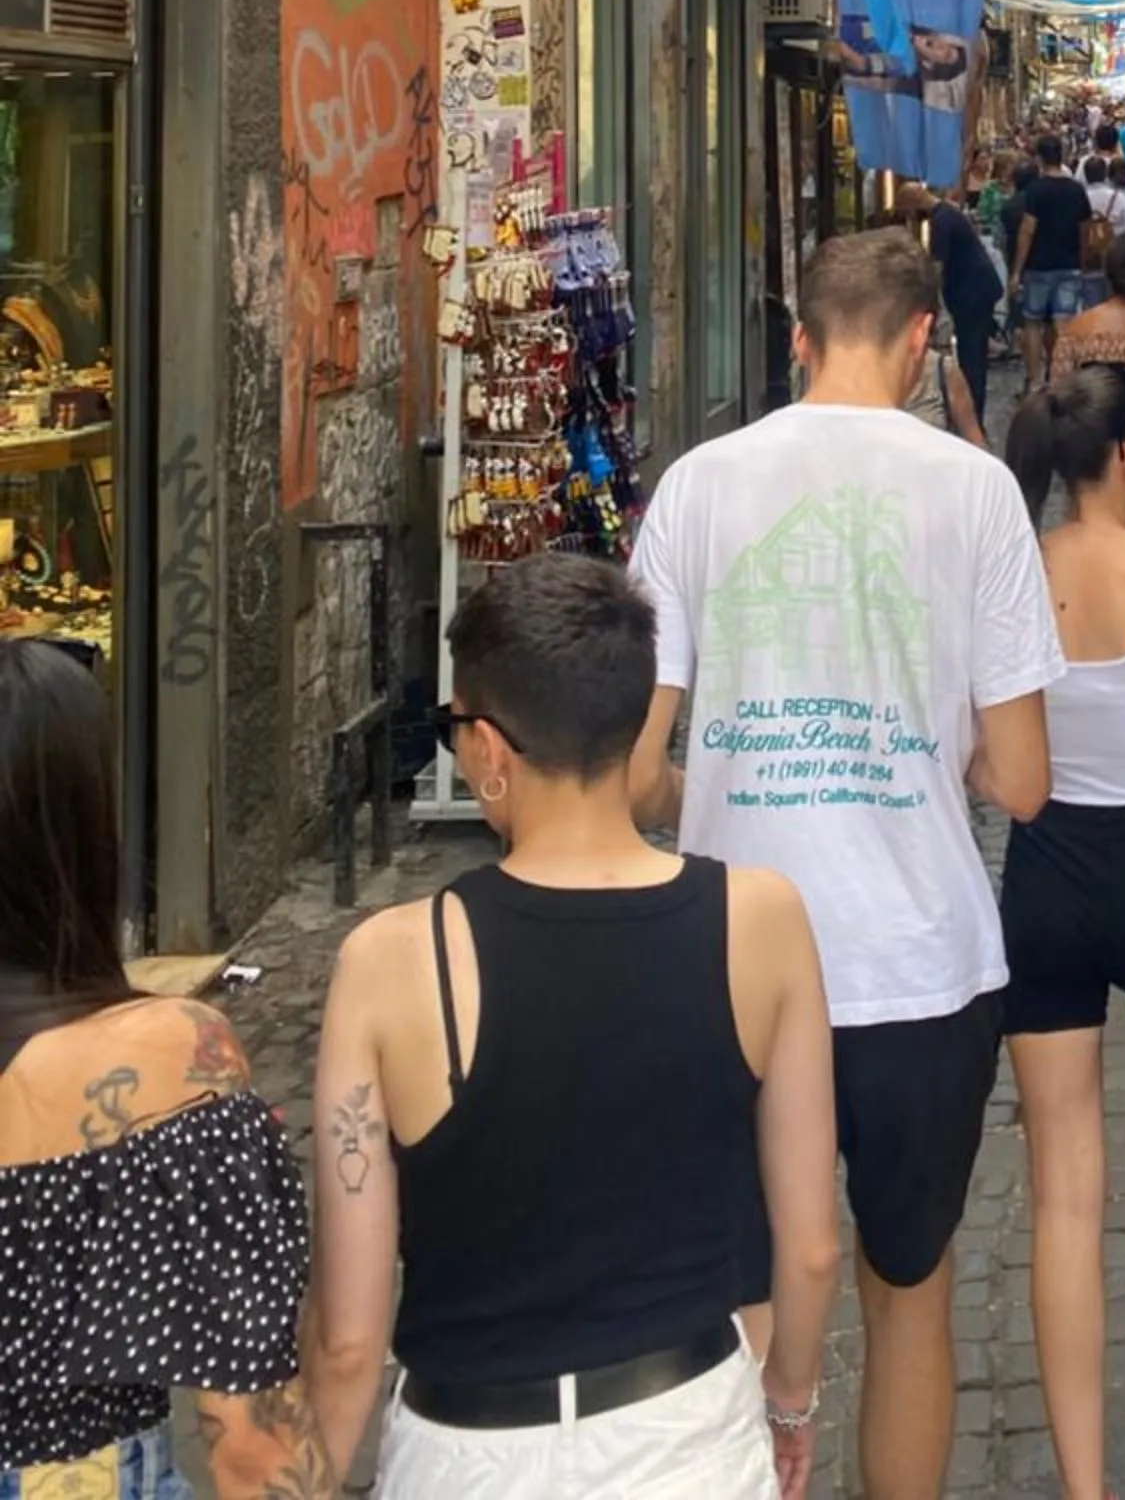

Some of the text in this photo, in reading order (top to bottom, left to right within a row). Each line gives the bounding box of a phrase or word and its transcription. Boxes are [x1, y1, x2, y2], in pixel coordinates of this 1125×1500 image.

[736, 700, 778, 719] CALL
[781, 698, 873, 721] RECEPTION
[702, 718, 796, 758] California
[793, 718, 872, 751] Beach
